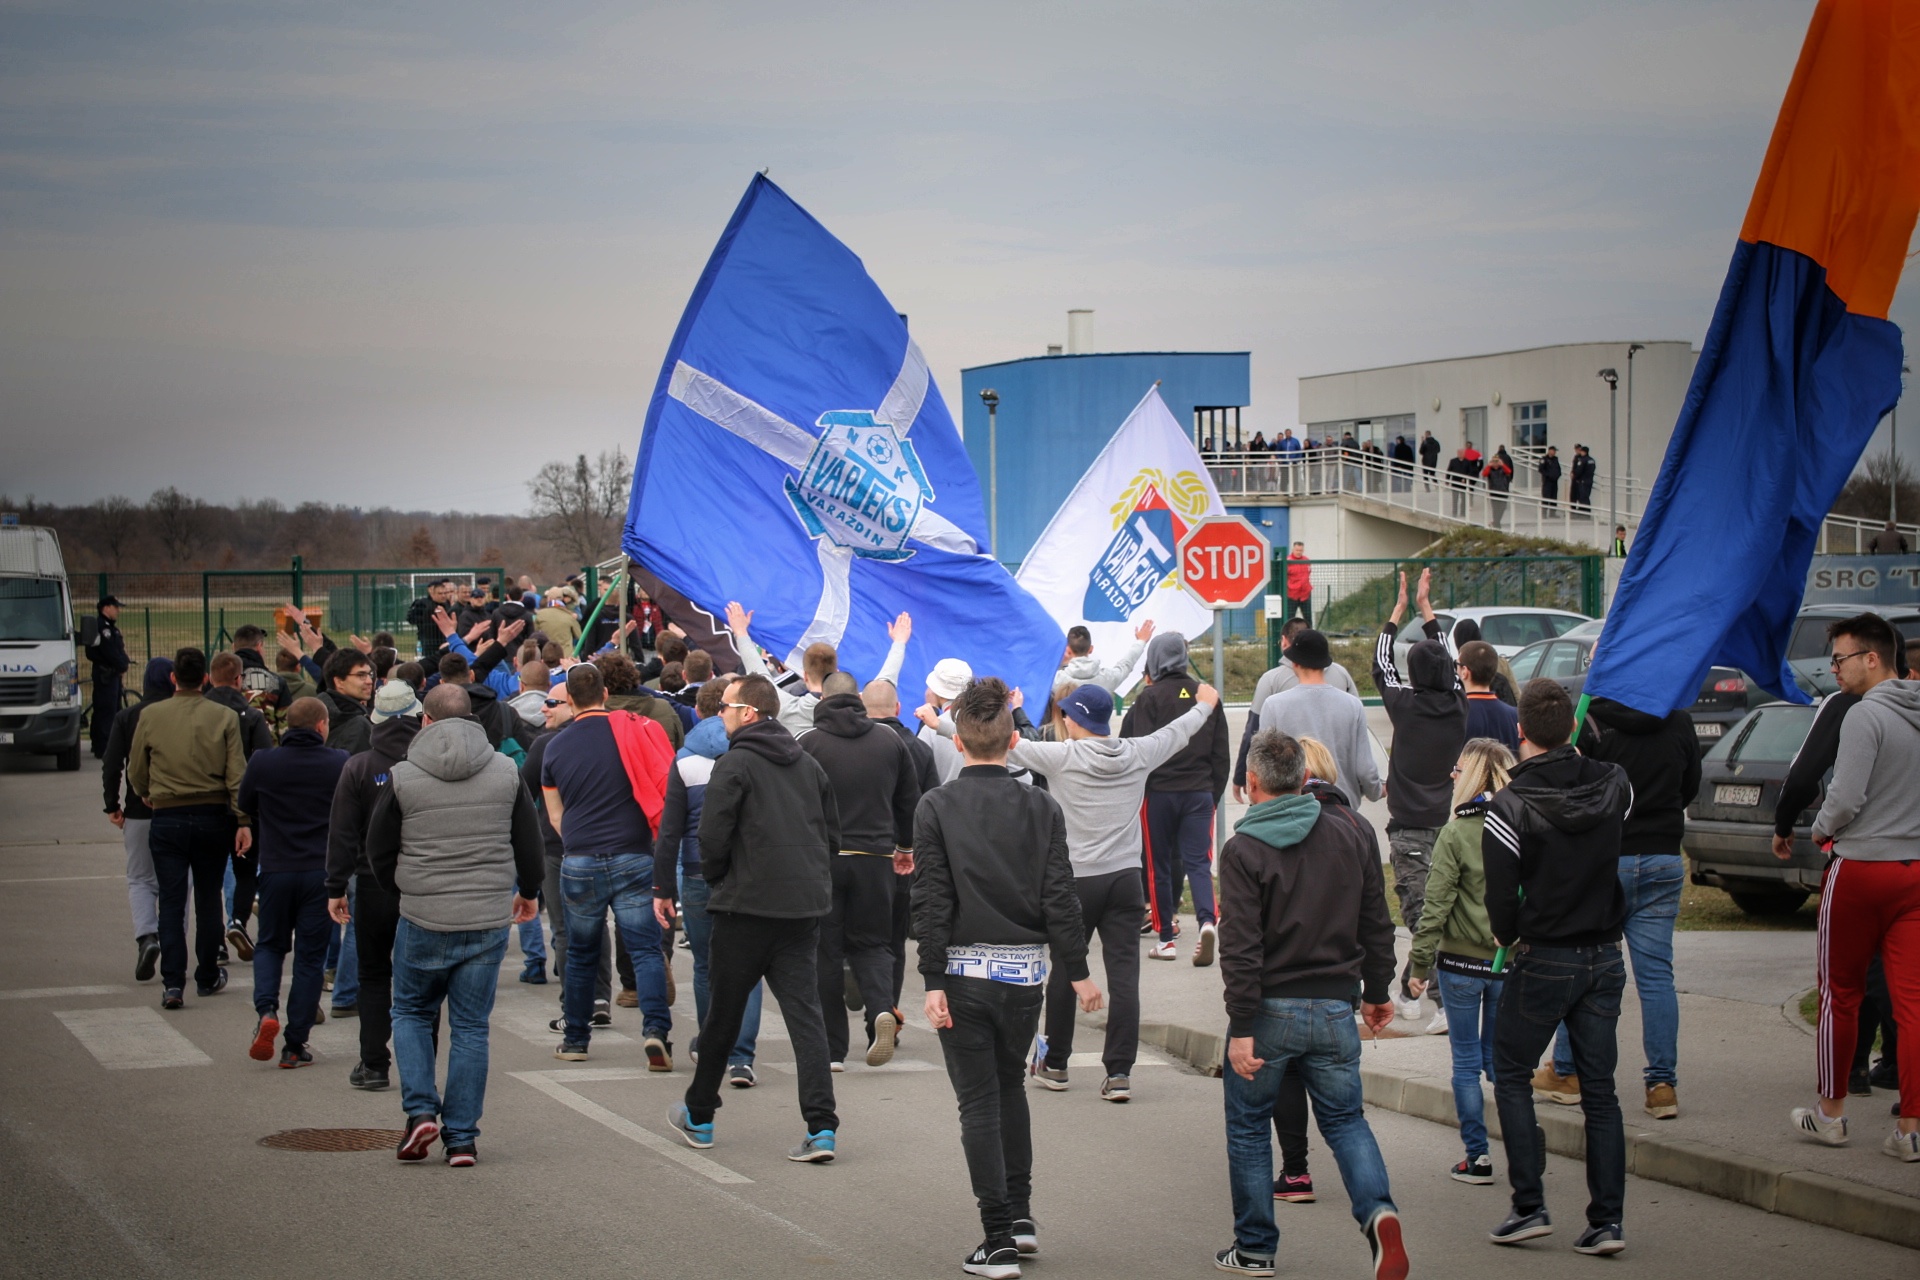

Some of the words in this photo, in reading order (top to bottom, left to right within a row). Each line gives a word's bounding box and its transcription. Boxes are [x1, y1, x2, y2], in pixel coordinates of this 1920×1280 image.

[847, 427, 859, 445] N
[894, 466, 908, 484] K
[810, 447, 912, 533] VARTEKS
[1141, 492, 1156, 510] N
[806, 492, 884, 547] VARAŽDIN
[1186, 545, 1261, 581] STOP
[1815, 569, 1877, 589] SRC
[992, 952, 1036, 960] OSTAVIT
